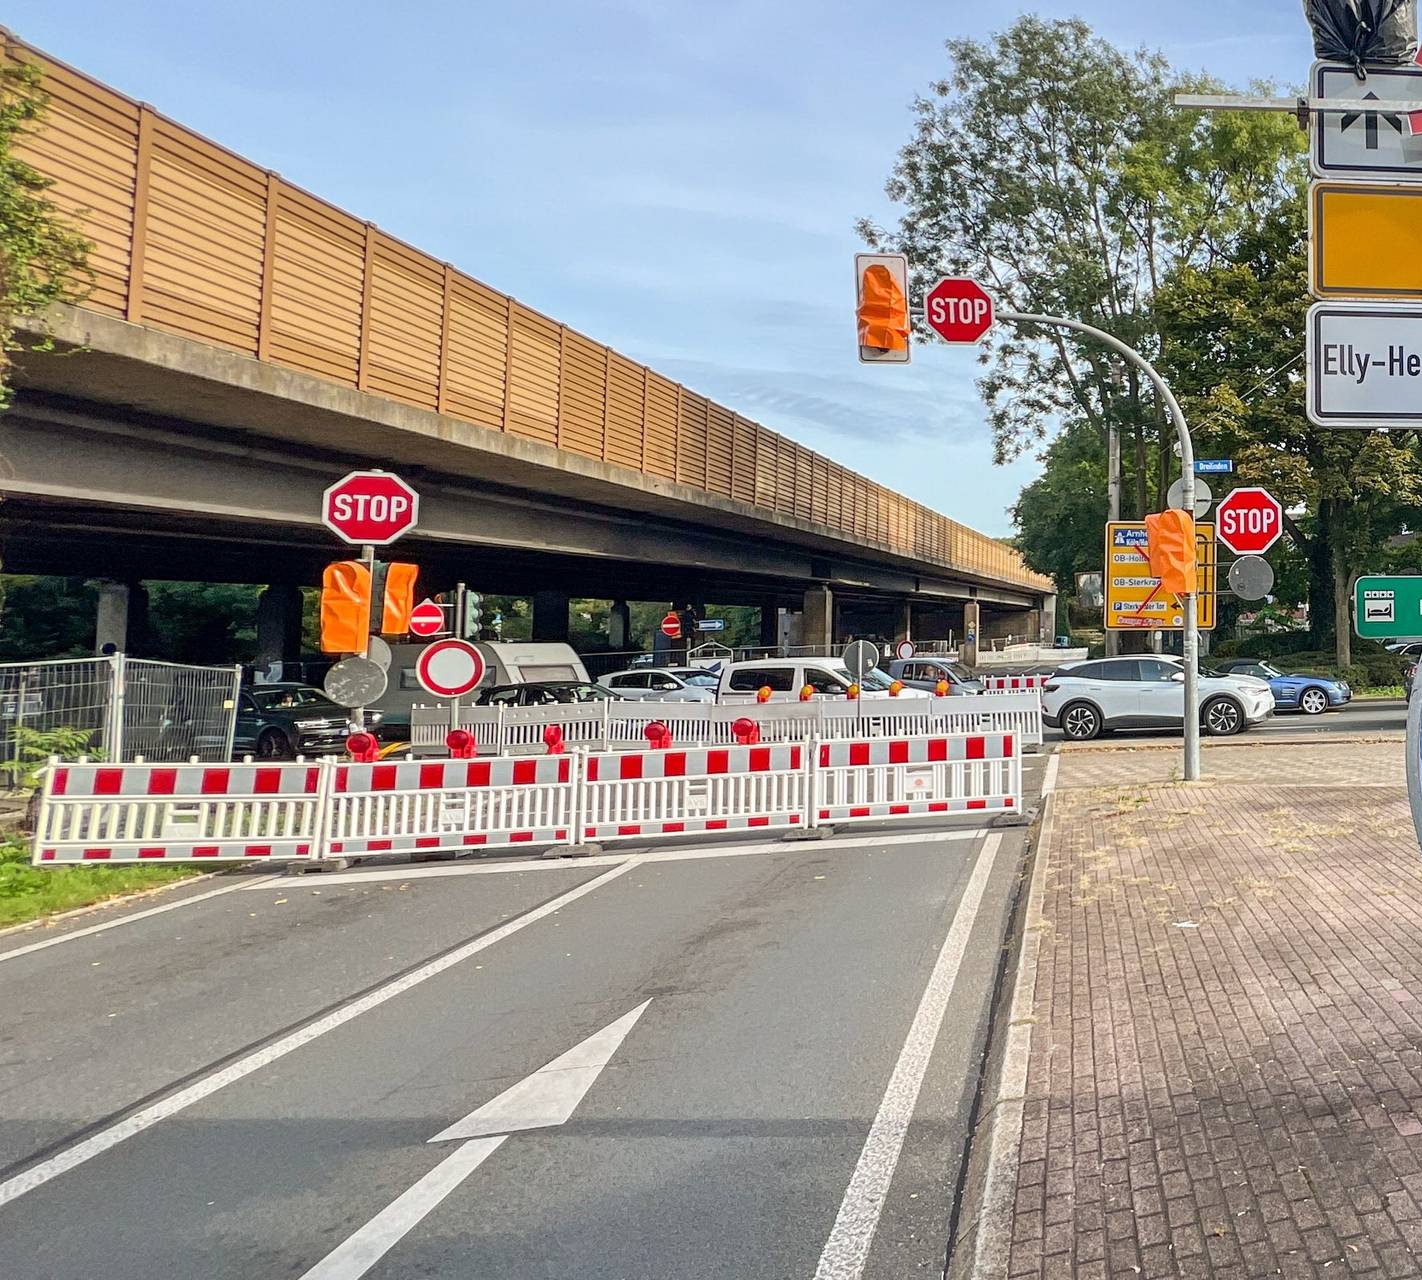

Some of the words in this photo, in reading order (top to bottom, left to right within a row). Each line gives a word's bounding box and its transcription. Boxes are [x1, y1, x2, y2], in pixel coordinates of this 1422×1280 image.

[931, 297, 988, 325] STOP
[333, 493, 408, 523] STOP
[1223, 508, 1275, 534] STOP
